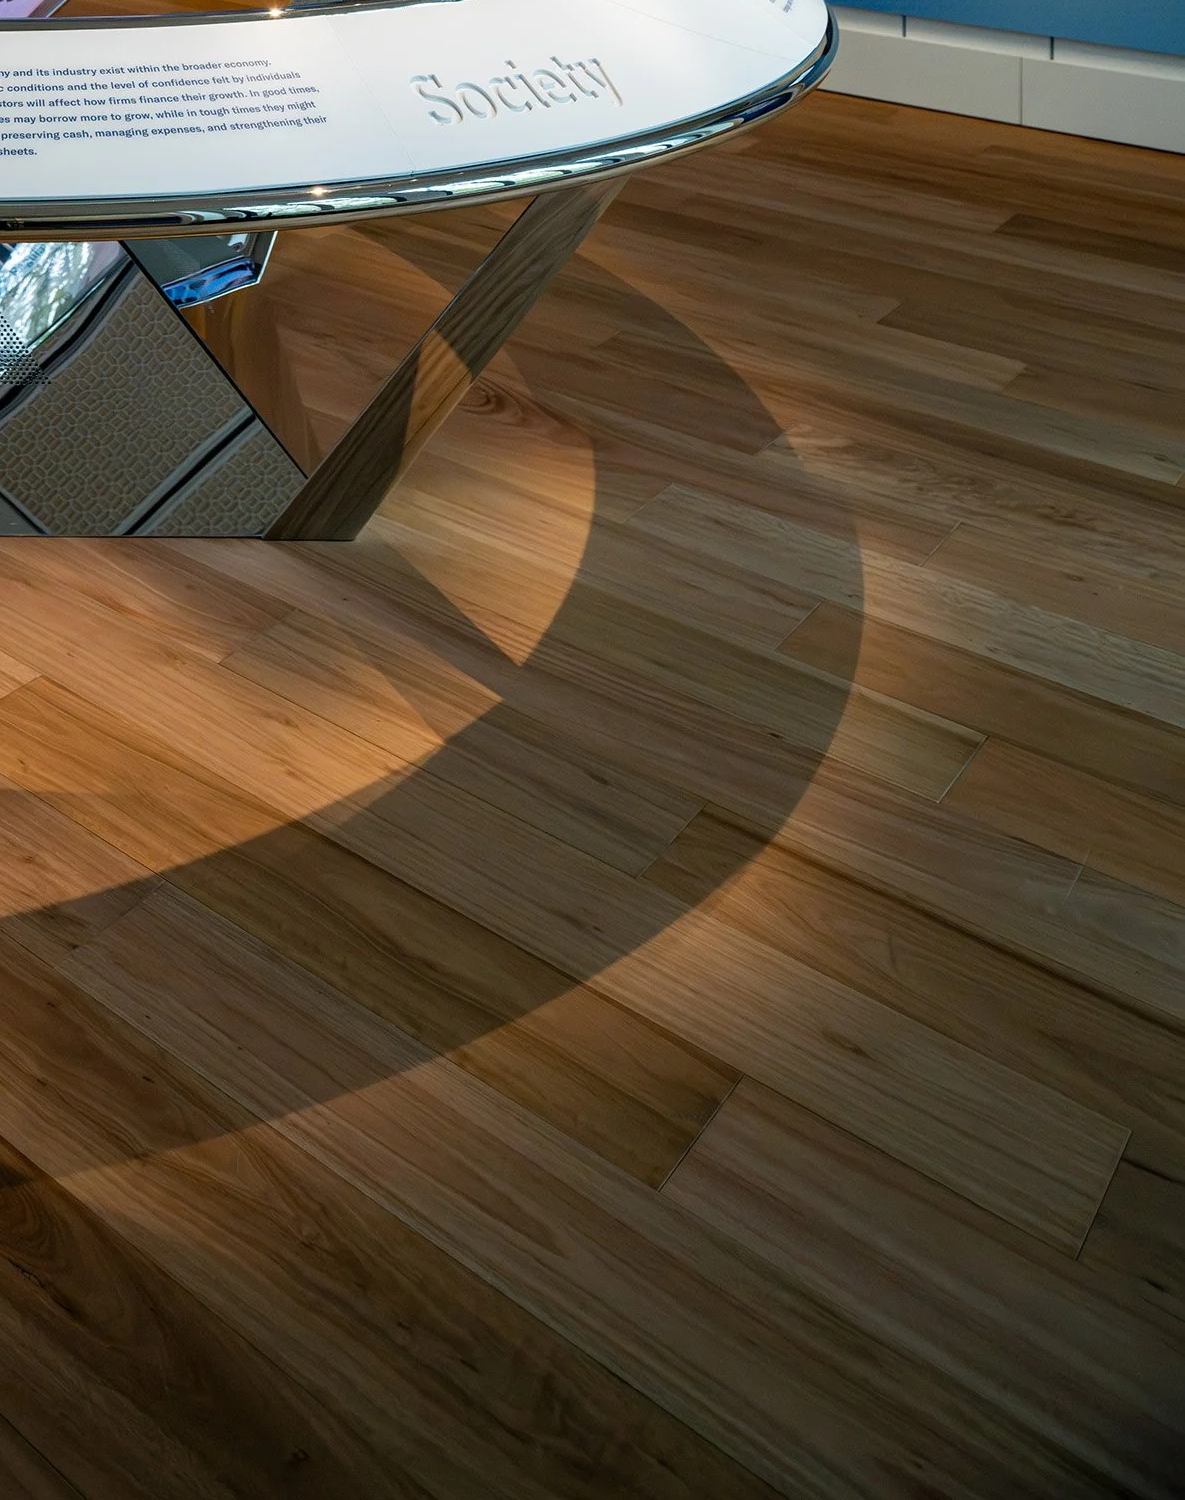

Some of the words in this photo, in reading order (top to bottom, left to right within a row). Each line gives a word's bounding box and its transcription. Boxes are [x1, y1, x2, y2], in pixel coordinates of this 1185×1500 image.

[12, 68, 33, 76] and
[35, 68, 50, 76] its
[52, 68, 97, 76] industry
[98, 66, 125, 74] exist
[126, 65, 160, 73] within
[181, 62, 222, 70] broader
[223, 60, 271, 68] economy.
[6, 83, 64, 92] conditions
[66, 82, 87, 90] and
[89, 82, 108, 90] the
[110, 81, 135, 89] level
[137, 79, 149, 88] of
[151, 78, 210, 87] confidence
[211, 76, 230, 84] felt
[230, 75, 244, 84] by
[245, 71, 301, 81] individuals
[410, 56, 623, 125] Society
[25, 99, 45, 107] will
[48, 98, 81, 106] affect
[108, 96, 137, 104] firms
[138, 95, 179, 103] finance
[180, 92, 206, 101] their
[208, 90, 248, 101] growth.
[248, 89, 260, 97] In
[261, 87, 287, 98] good
[287, 86, 320, 94] times,
[13, 116, 36, 124] may
[38, 114, 77, 122] borrow
[124, 113, 153, 122] grow,
[154, 109, 184, 118] while
[185, 108, 197, 116] in
[198, 107, 230, 117] tough
[231, 106, 261, 114] times
[261, 103, 285, 112] they
[286, 101, 316, 110] might
[0, 131, 60, 140] preserving
[62, 130, 92, 138] cash,
[94, 128, 149, 138] managing
[150, 126, 205, 135] expenses,
[206, 122, 227, 131] and
[229, 118, 303, 130] strengthening
[301, 115, 327, 125] their
